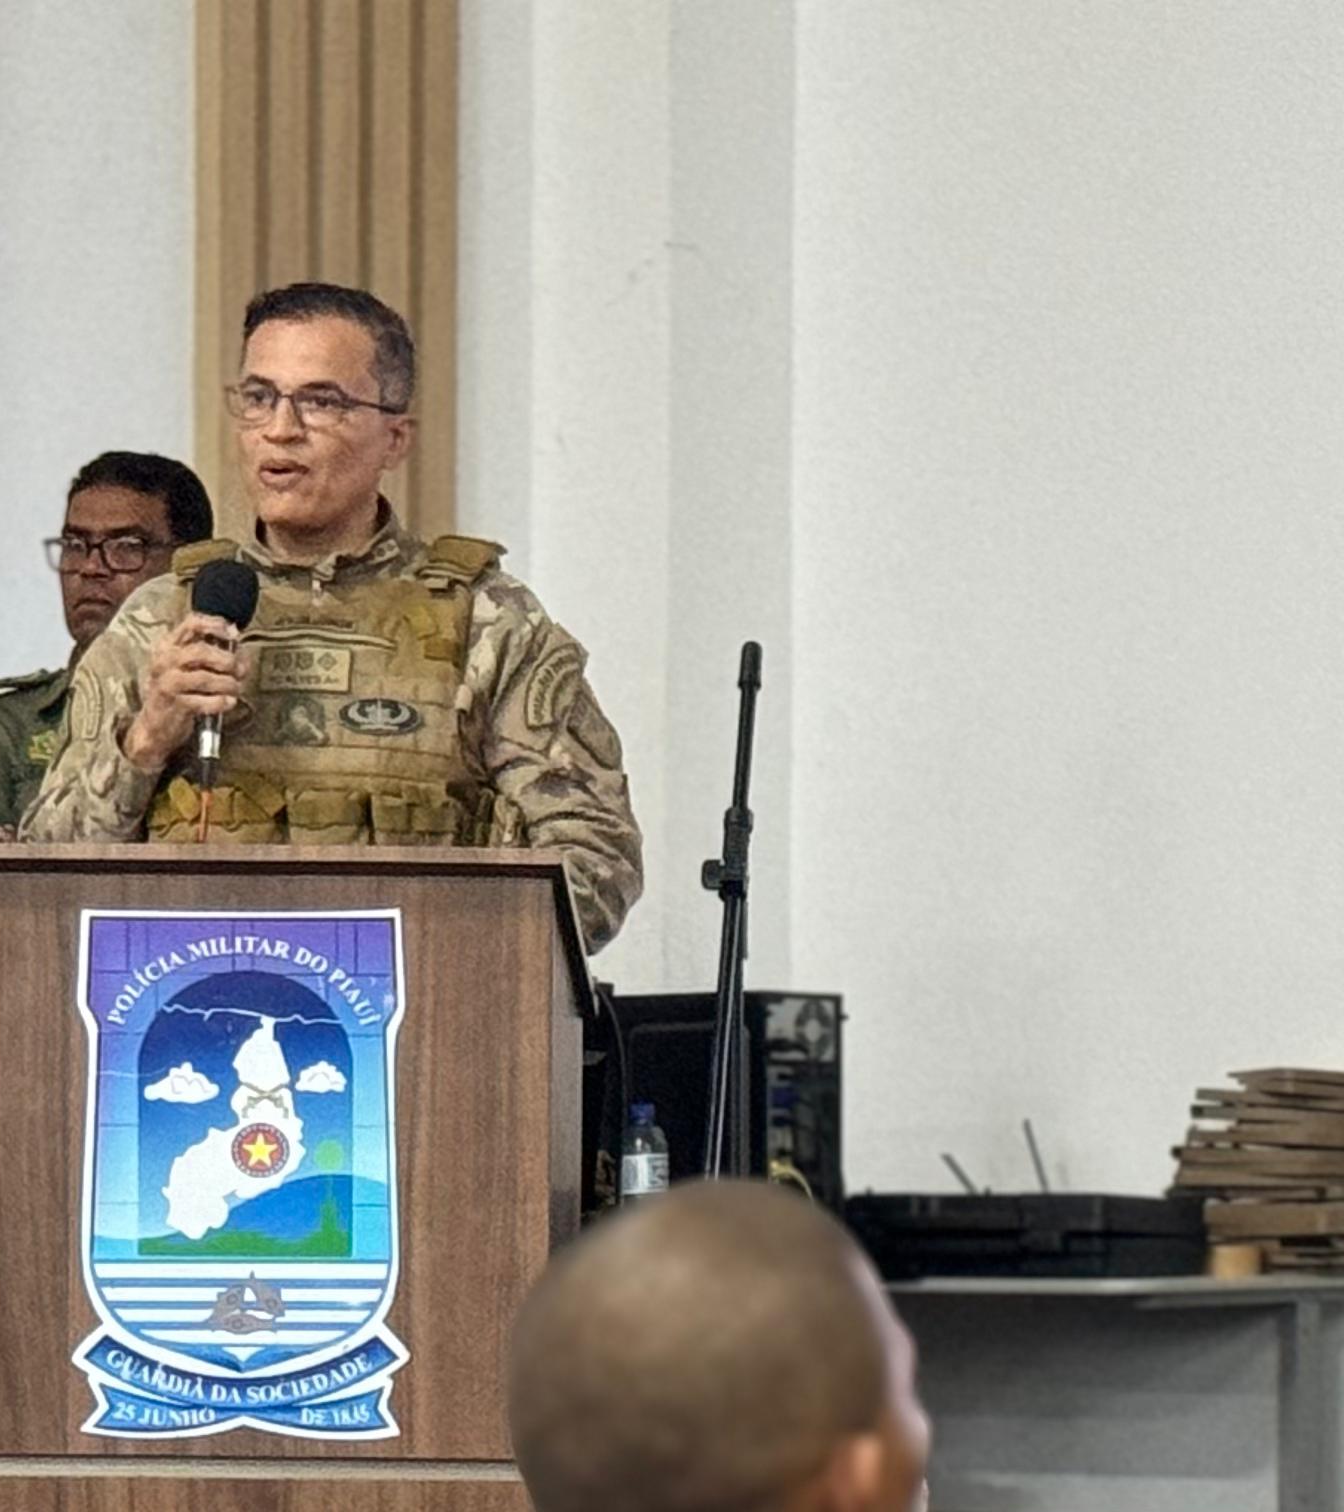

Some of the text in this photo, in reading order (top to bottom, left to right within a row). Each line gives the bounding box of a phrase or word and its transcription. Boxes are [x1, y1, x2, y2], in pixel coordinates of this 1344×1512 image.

[106, 935, 382, 1026] POLÍCIA MILITAR DO PIAUÍ
[210, 1382, 243, 1405] DA
[245, 1352, 373, 1403] SOCIEDADE
[111, 1401, 137, 1422] 25
[301, 1406, 326, 1426] DE
